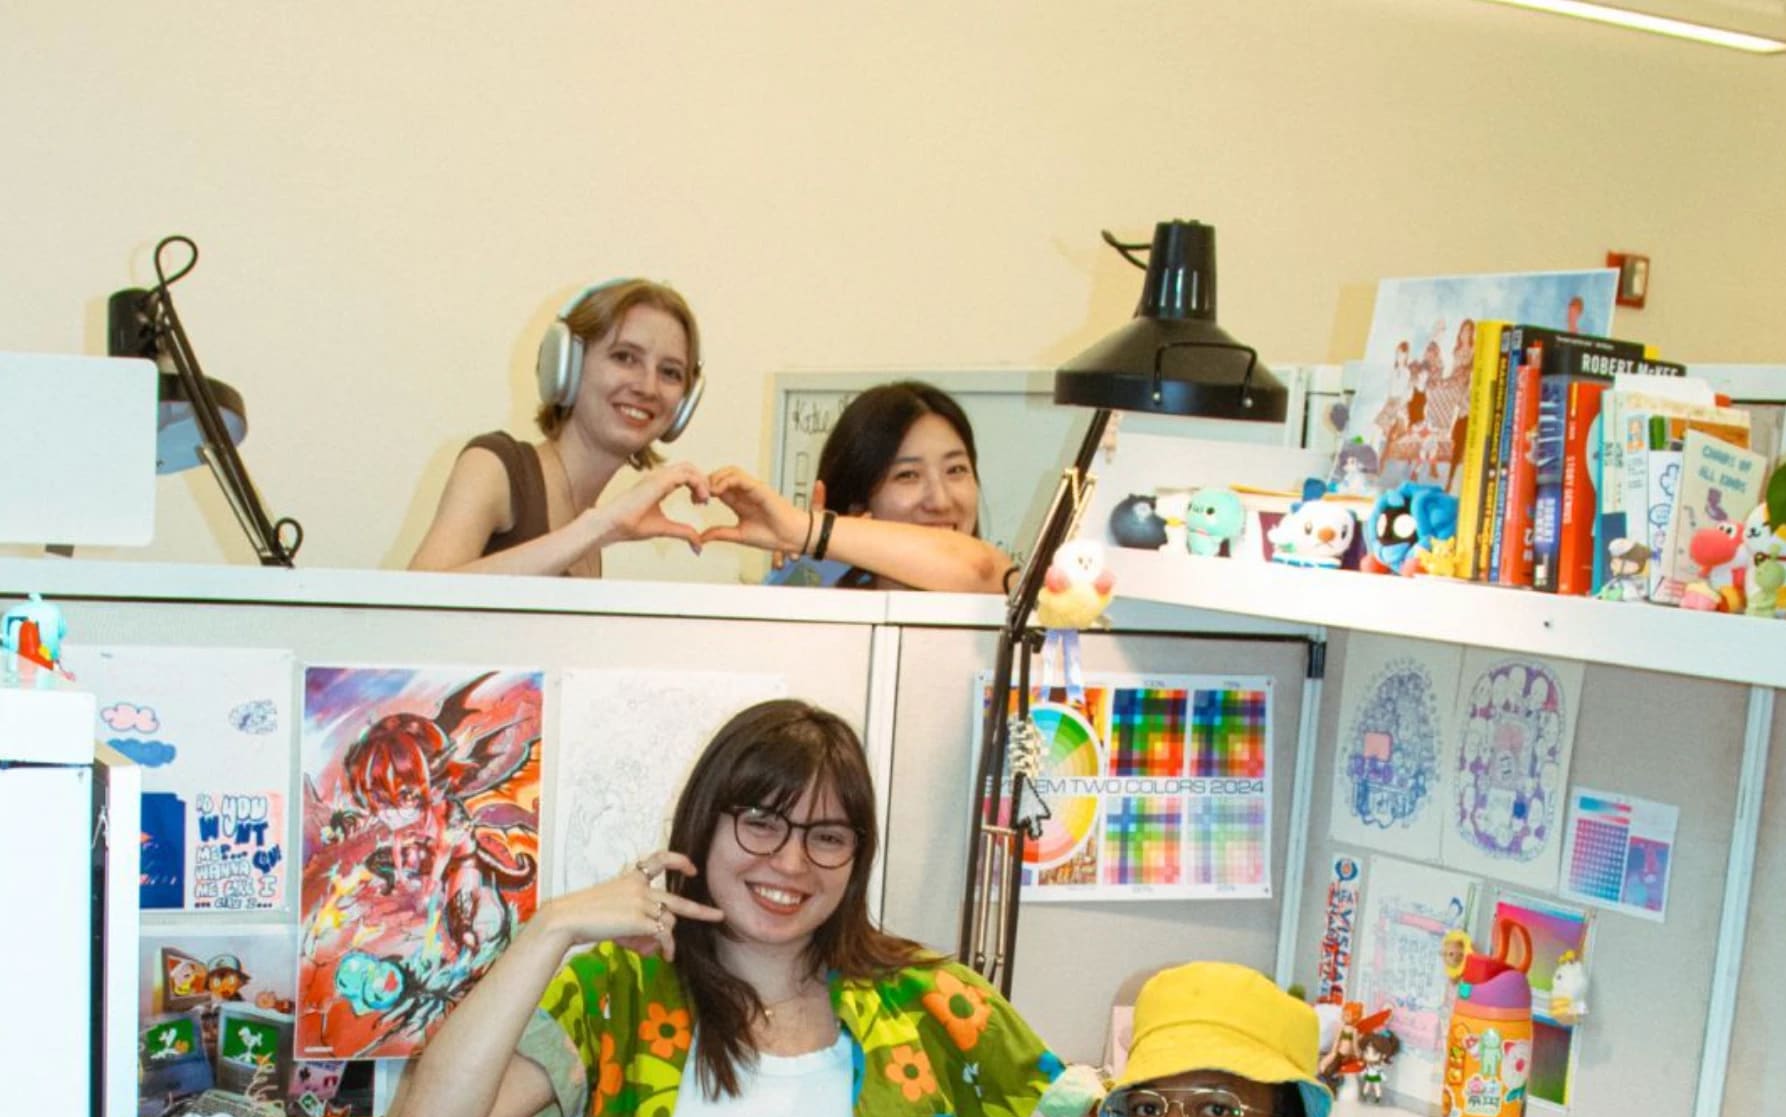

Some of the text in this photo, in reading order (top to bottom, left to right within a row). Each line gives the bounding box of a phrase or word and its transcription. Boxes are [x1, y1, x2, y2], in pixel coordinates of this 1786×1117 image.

[1581, 353, 1634, 376] ROBERT
[1071, 778, 1121, 794] TWO
[1125, 779, 1206, 795] COLORS
[1209, 779, 1264, 795] 2024
